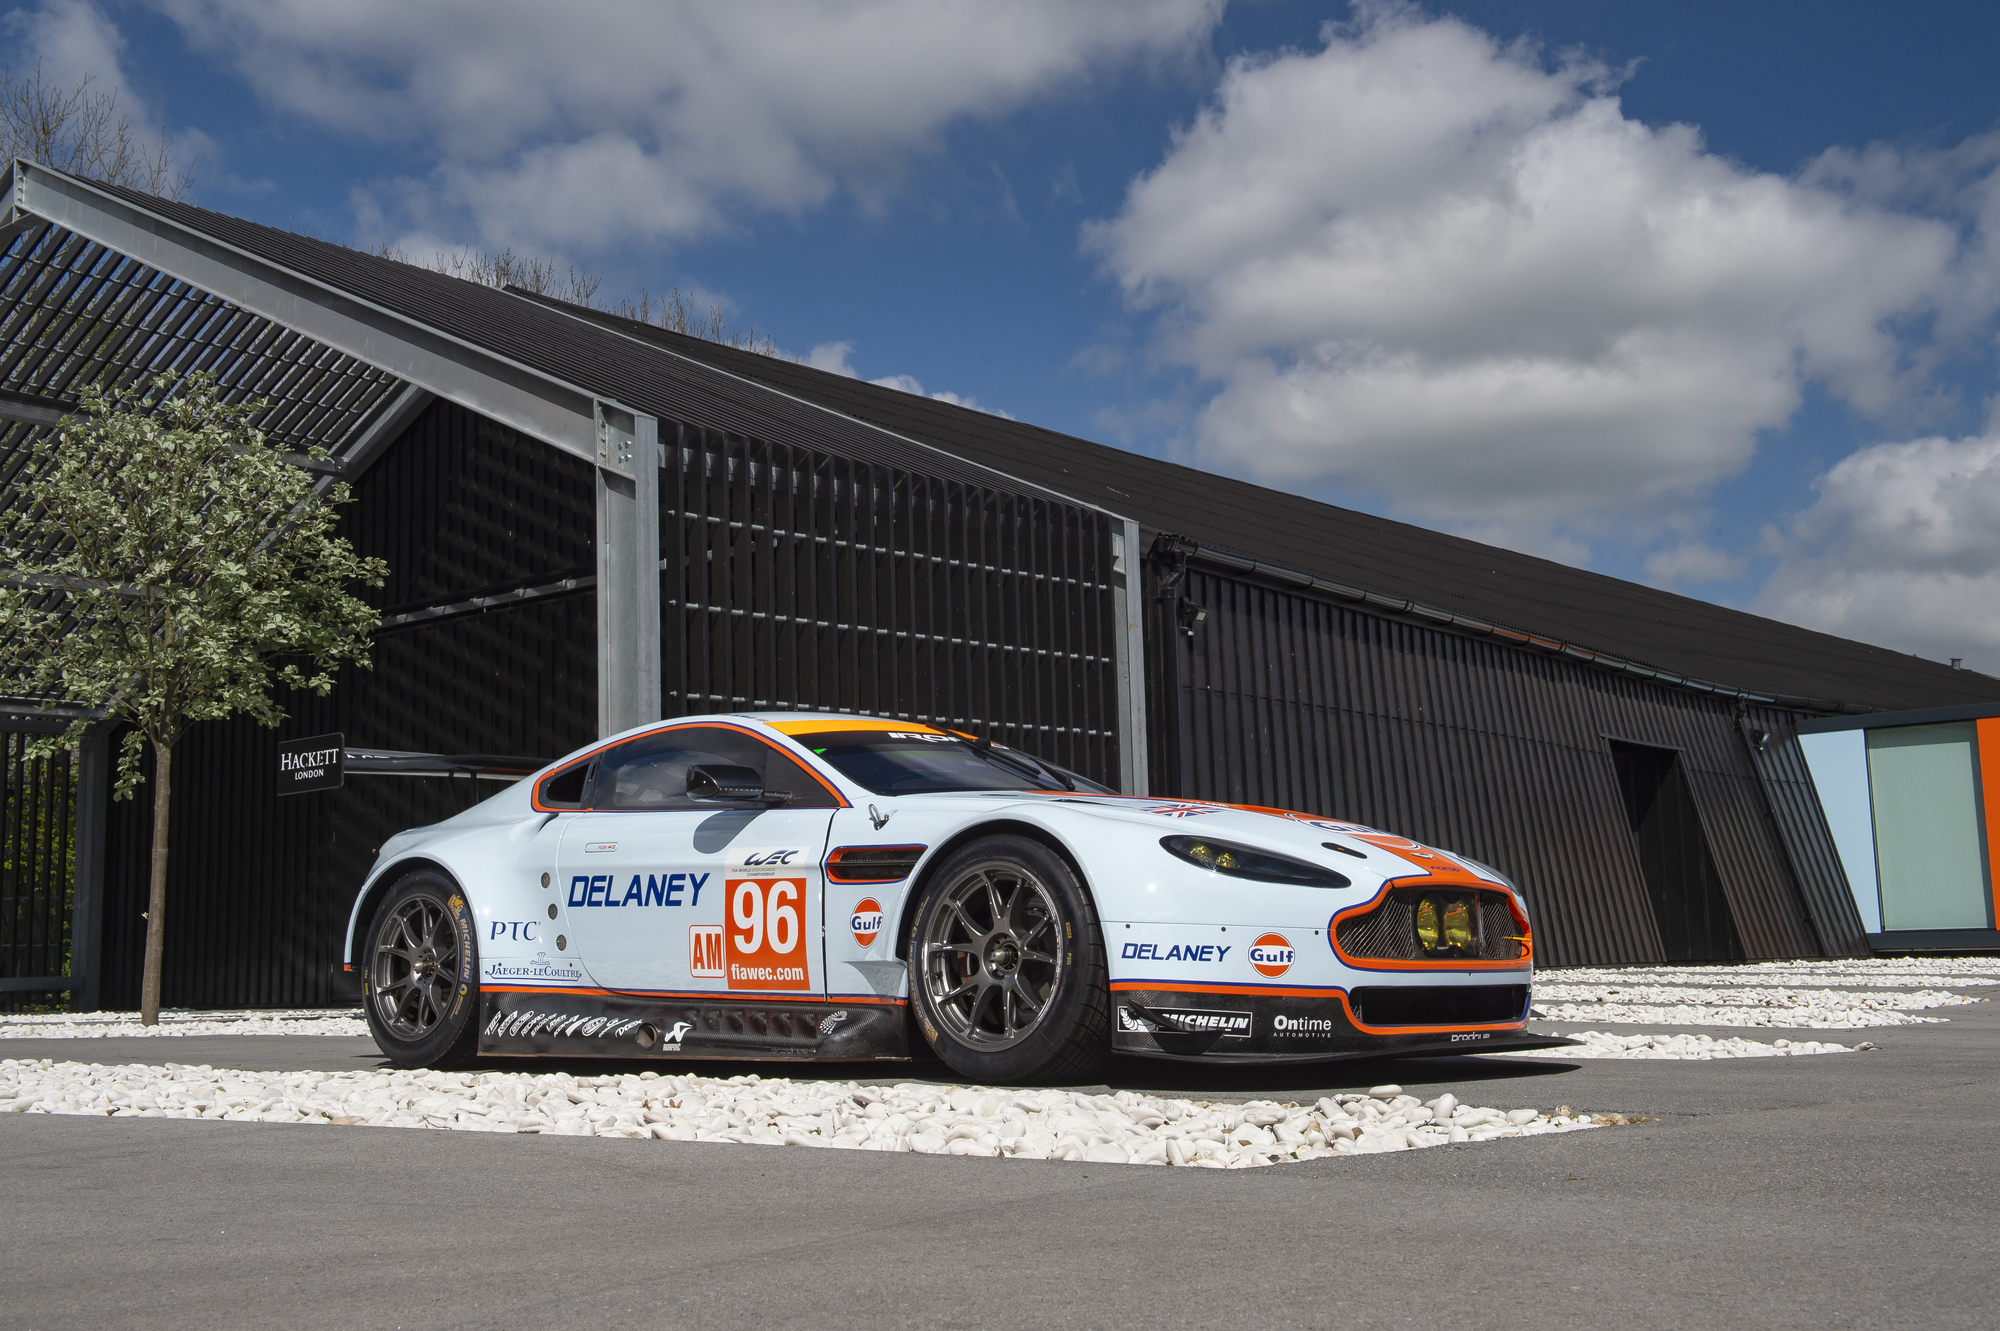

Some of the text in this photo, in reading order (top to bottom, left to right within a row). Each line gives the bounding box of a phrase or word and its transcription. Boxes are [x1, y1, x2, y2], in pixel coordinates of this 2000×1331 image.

[281, 748, 339, 771] HACKETT
[295, 769, 324, 780] LONDON
[743, 850, 799, 866] WEC
[568, 873, 711, 907] DELANEY
[733, 881, 799, 954] 96
[851, 915, 882, 931] Gulf
[490, 921, 537, 941] PTC
[460, 918, 471, 979] MICHELIN
[693, 933, 722, 970] AM
[1121, 943, 1232, 962] DELANEY
[1250, 948, 1294, 963] Gulf
[731, 964, 804, 980] fiawec.com
[521, 1013, 545, 1037] RECARO
[1274, 1015, 1332, 1030] Ontime
